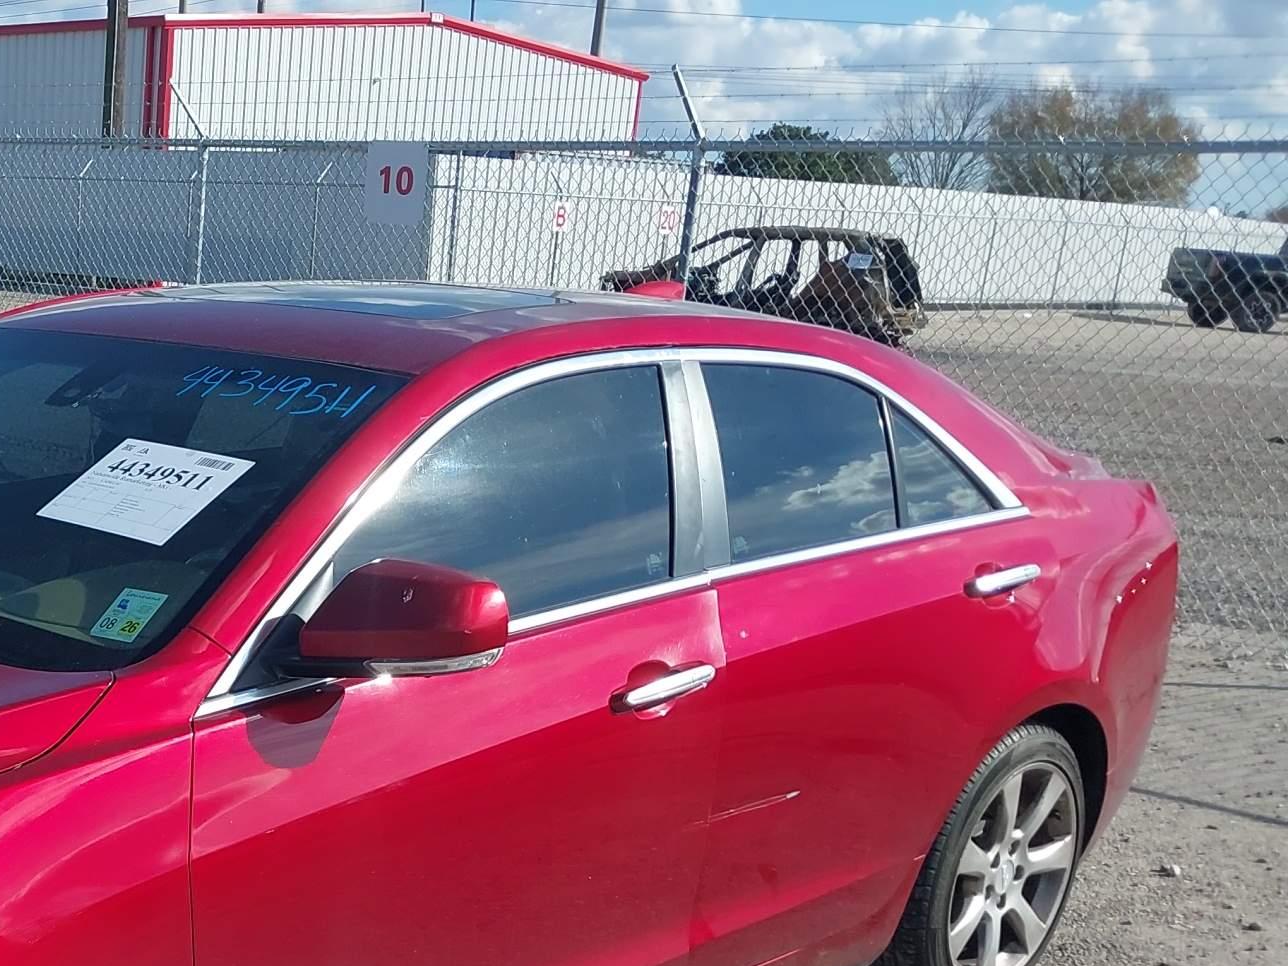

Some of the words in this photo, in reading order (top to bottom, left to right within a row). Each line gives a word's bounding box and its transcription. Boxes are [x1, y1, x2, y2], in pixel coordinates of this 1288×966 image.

[379, 165, 414, 196] 10
[661, 209, 677, 232] 20
[107, 458, 214, 491] 44349511
[120, 620, 140, 634] 26
